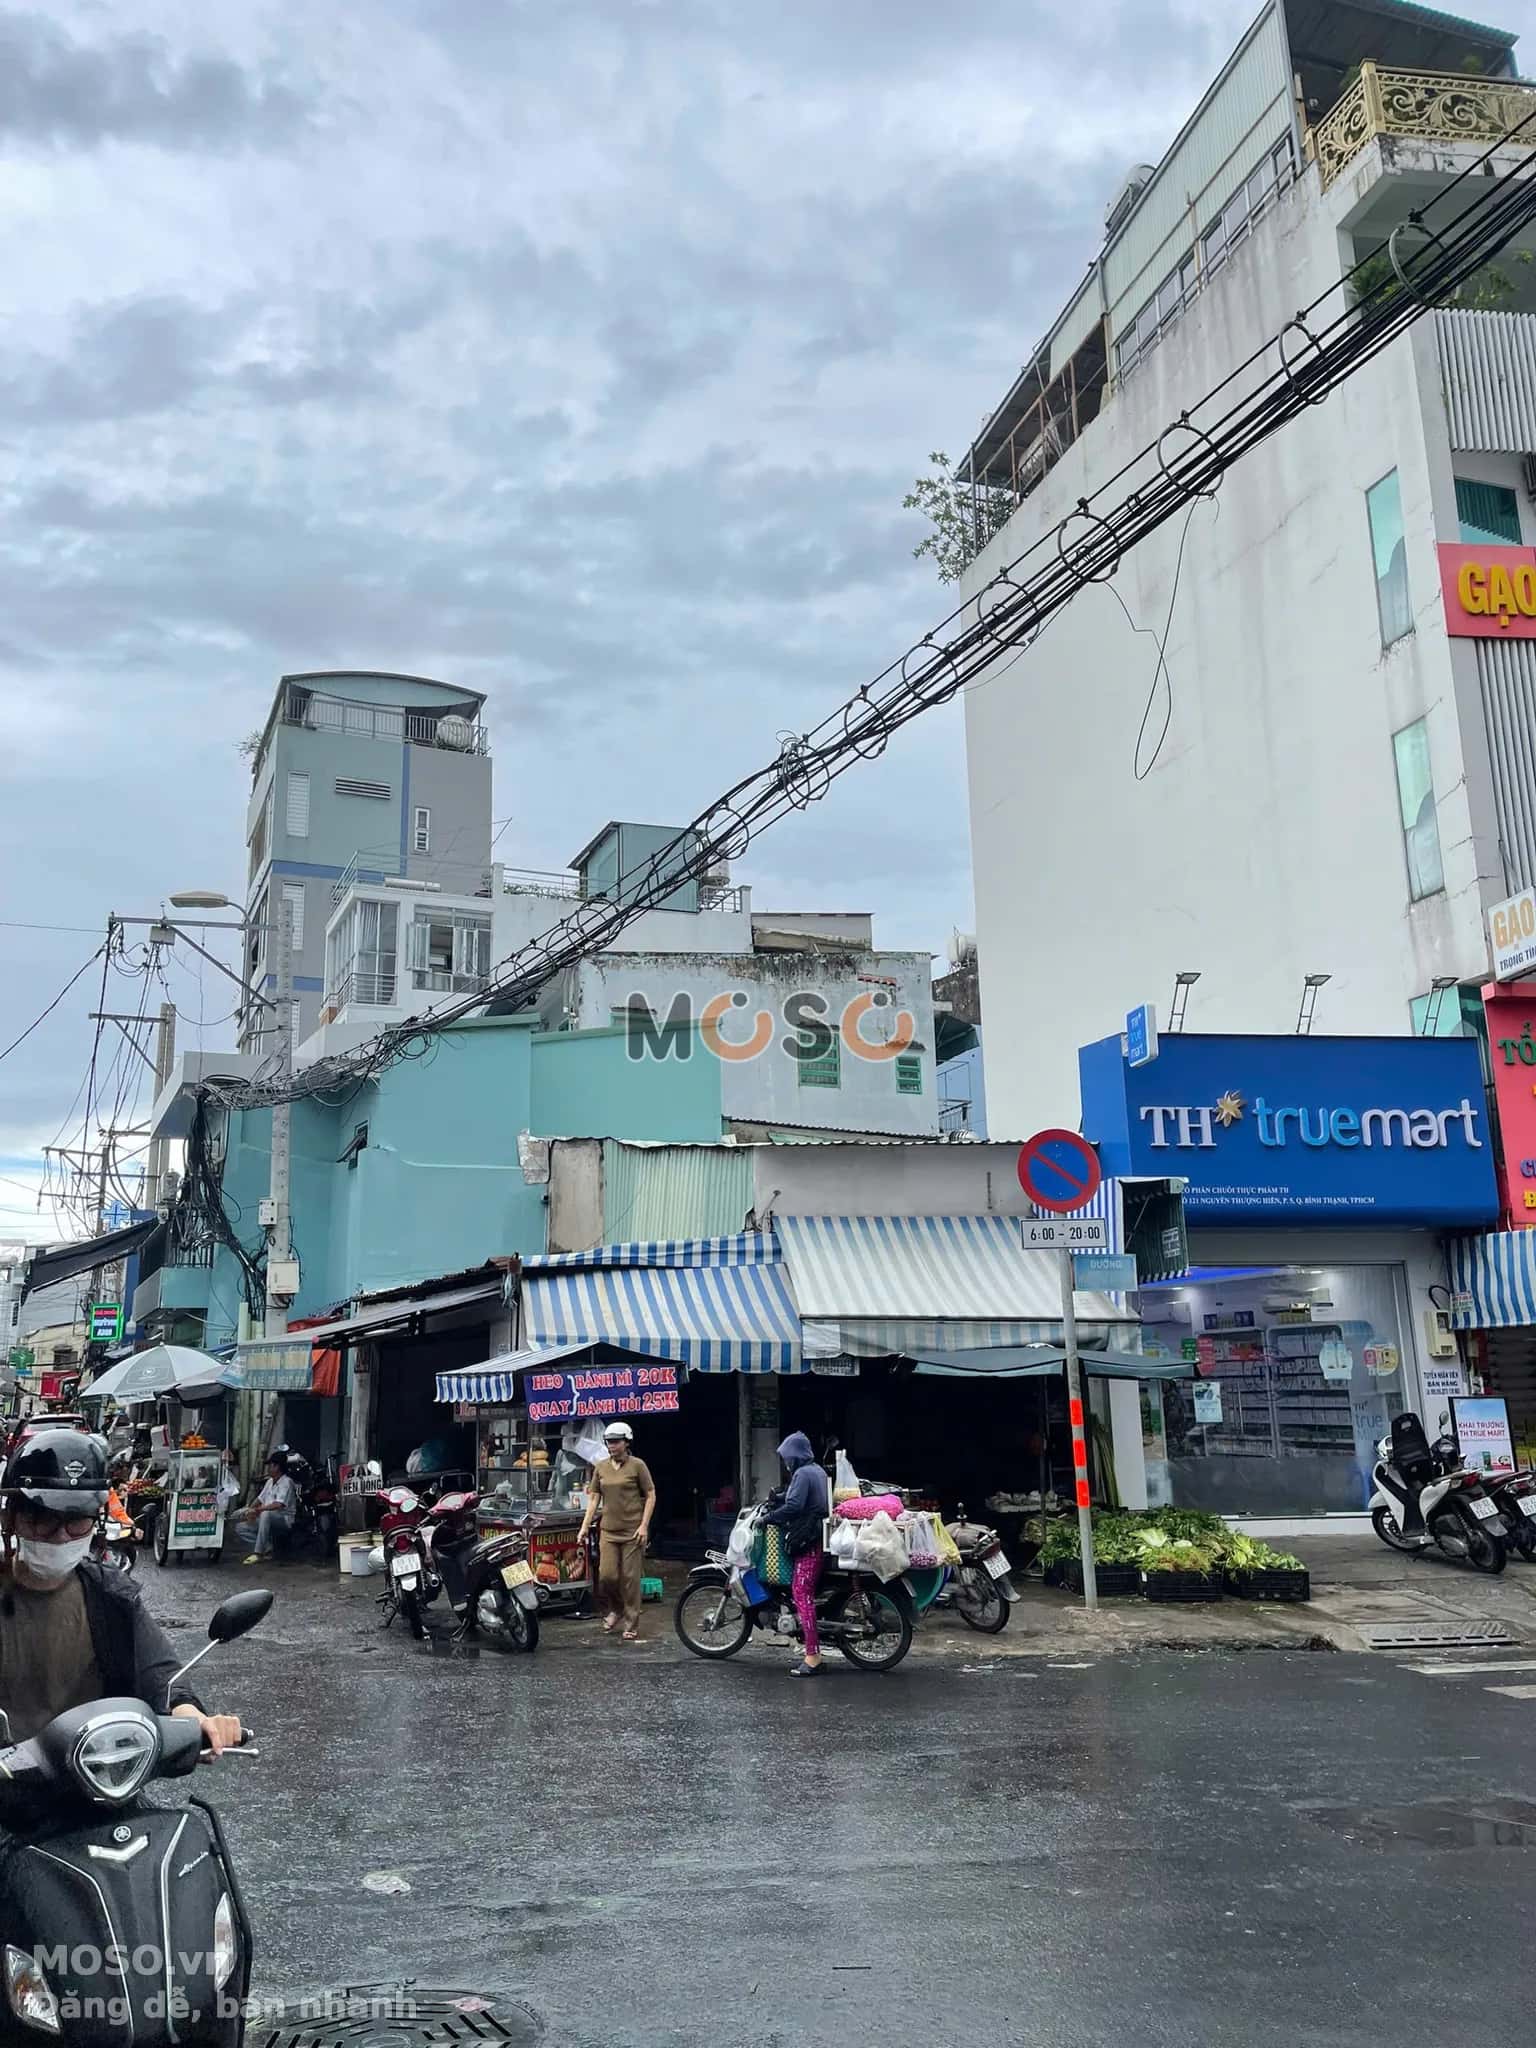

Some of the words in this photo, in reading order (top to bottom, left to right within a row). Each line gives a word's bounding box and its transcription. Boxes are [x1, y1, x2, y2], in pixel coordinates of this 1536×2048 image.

[1458, 562, 1536, 628] GẠO
[1494, 897, 1534, 950] GẠO
[1140, 1106, 1217, 1148] TH
[1189, 1197, 1200, 1205] 121
[1031, 1226, 1055, 1241] 6:00
[1069, 1226, 1100, 1240] 20:00
[532, 1375, 564, 1391] HEO
[575, 1371, 613, 1389] BÁNH
[615, 1367, 633, 1386] MÌ
[637, 1367, 677, 1386] 20K
[528, 1401, 570, 1422] QUAY
[577, 1397, 616, 1416] BÁNH
[618, 1391, 641, 1412] HỎI
[642, 1390, 679, 1410] 25K
